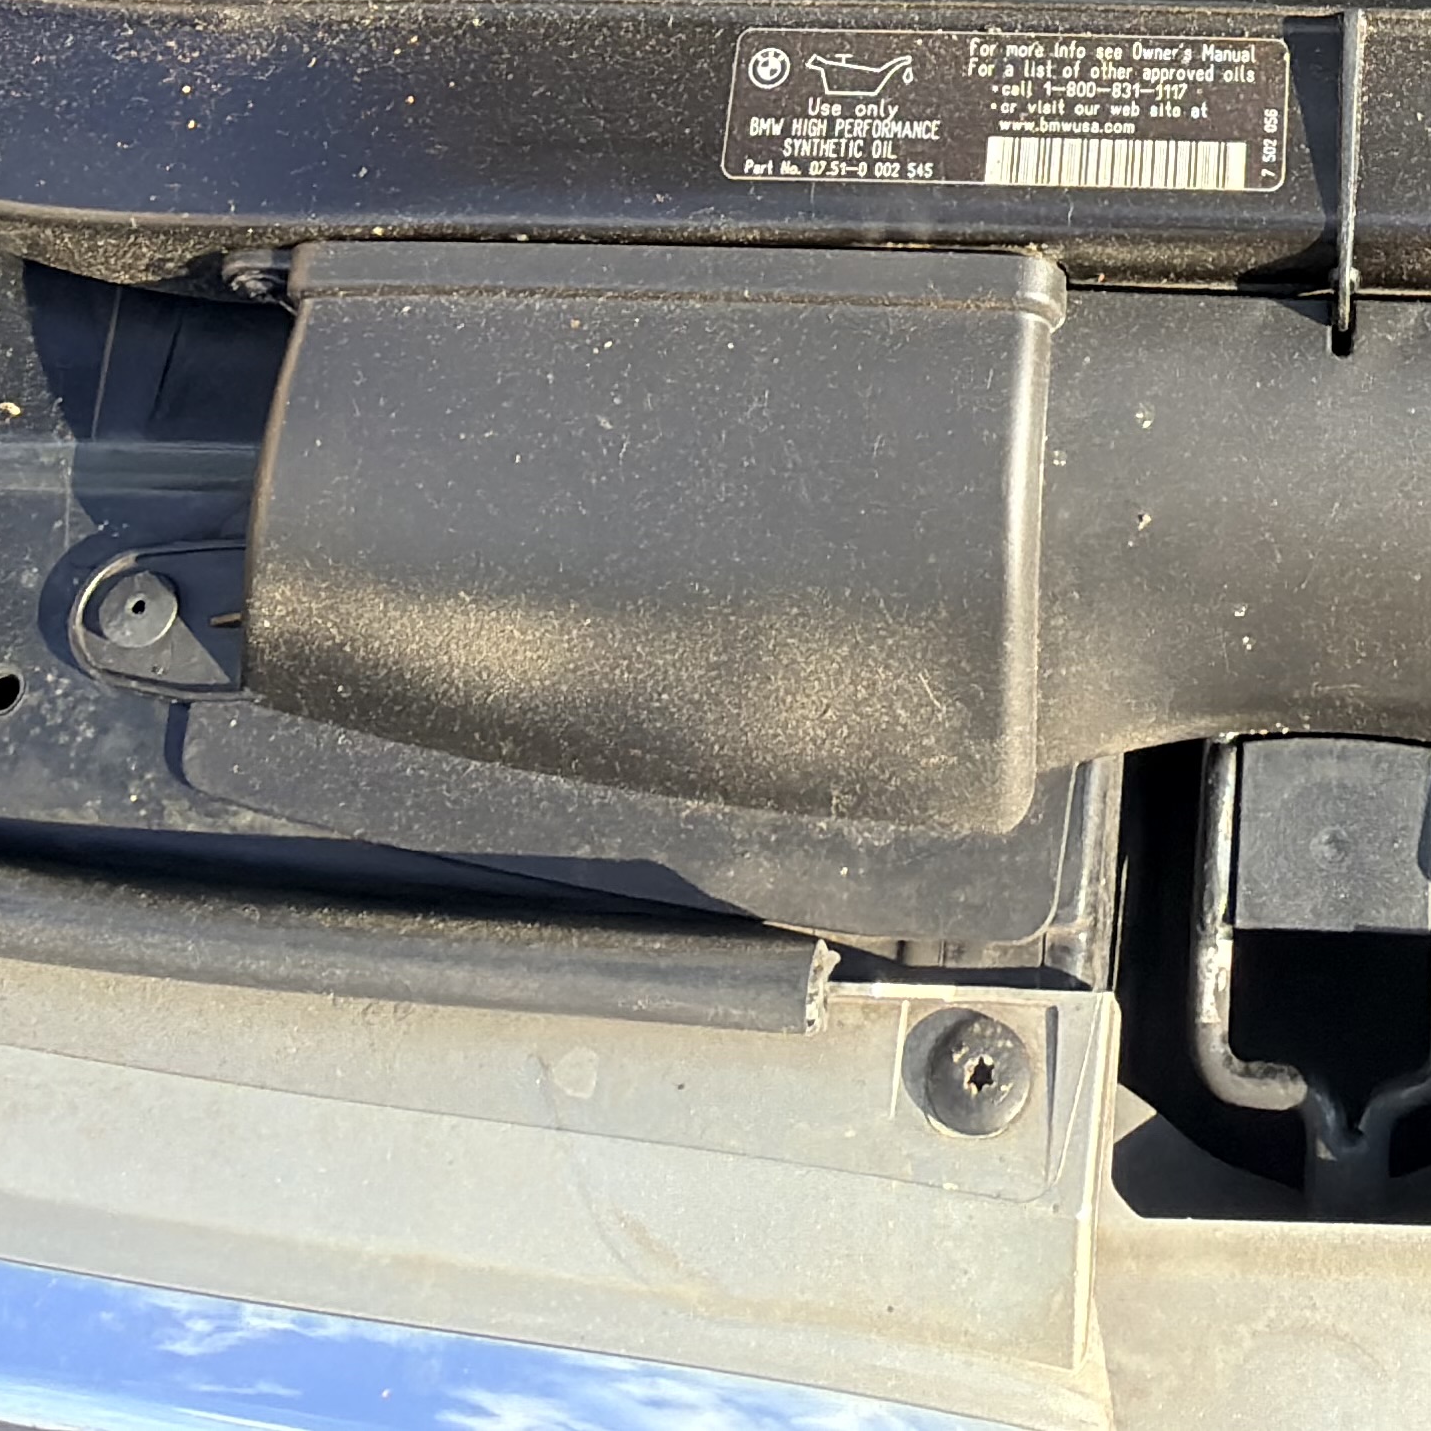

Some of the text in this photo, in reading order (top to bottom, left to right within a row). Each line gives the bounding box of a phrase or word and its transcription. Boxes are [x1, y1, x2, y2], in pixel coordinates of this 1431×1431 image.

[971, 41, 997, 57] For
[1006, 45, 1043, 58] more
[1096, 46, 1122, 60] see
[1132, 42, 1192, 64] Owner's
[1202, 44, 1256, 63] Manual
[968, 60, 1255, 83] For a list of other approved oils
[1043, 81, 1187, 101] 1-800-831-1117
[808, 97, 899, 121] Use only
[1028, 100, 1065, 115] visit
[1074, 102, 1101, 117] our
[1111, 102, 1139, 117] web
[1150, 104, 1181, 119] site
[1191, 102, 1208, 119] at
[750, 117, 941, 139] BMW HIGH PERFORMANCE
[999, 119, 1135, 134] www.bmwusa.com
[783, 139, 897, 159] SYNTHETIC OIL
[1261, 108, 1279, 178] 7 502 056
[744, 160, 773, 175] Part
[875, 163, 899, 177] 002
[907, 163, 933, 177] 545
